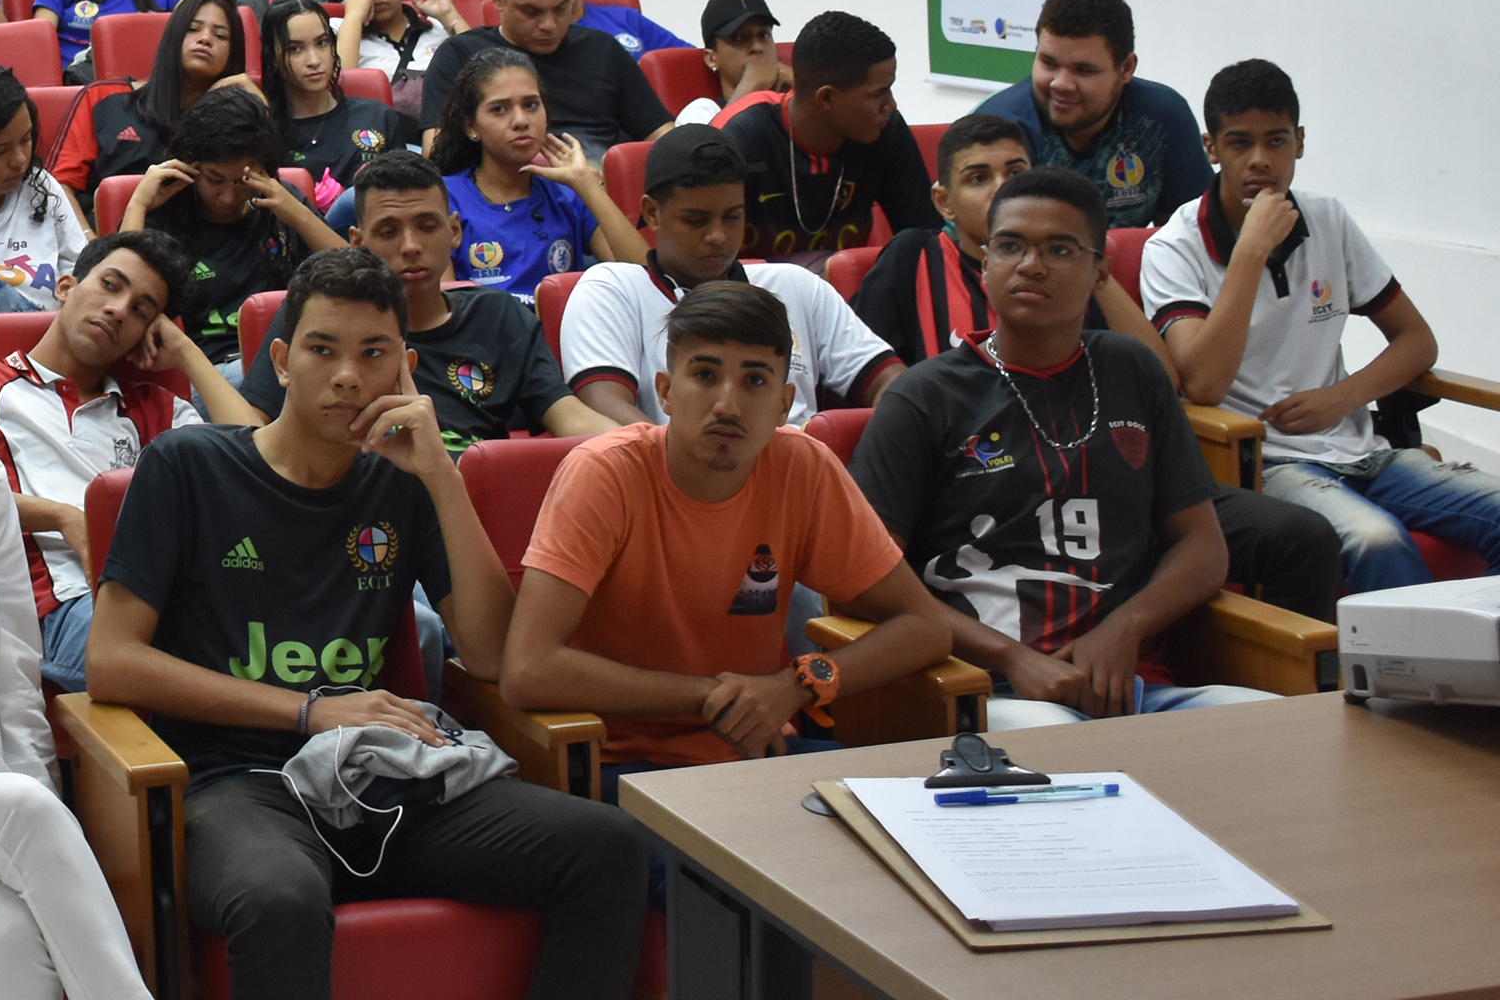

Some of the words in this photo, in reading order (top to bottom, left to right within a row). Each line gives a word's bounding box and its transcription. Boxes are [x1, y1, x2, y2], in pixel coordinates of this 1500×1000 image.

[7, 238, 28, 251] liga
[1035, 498, 1102, 560] 19
[221, 556, 264, 571] adidas
